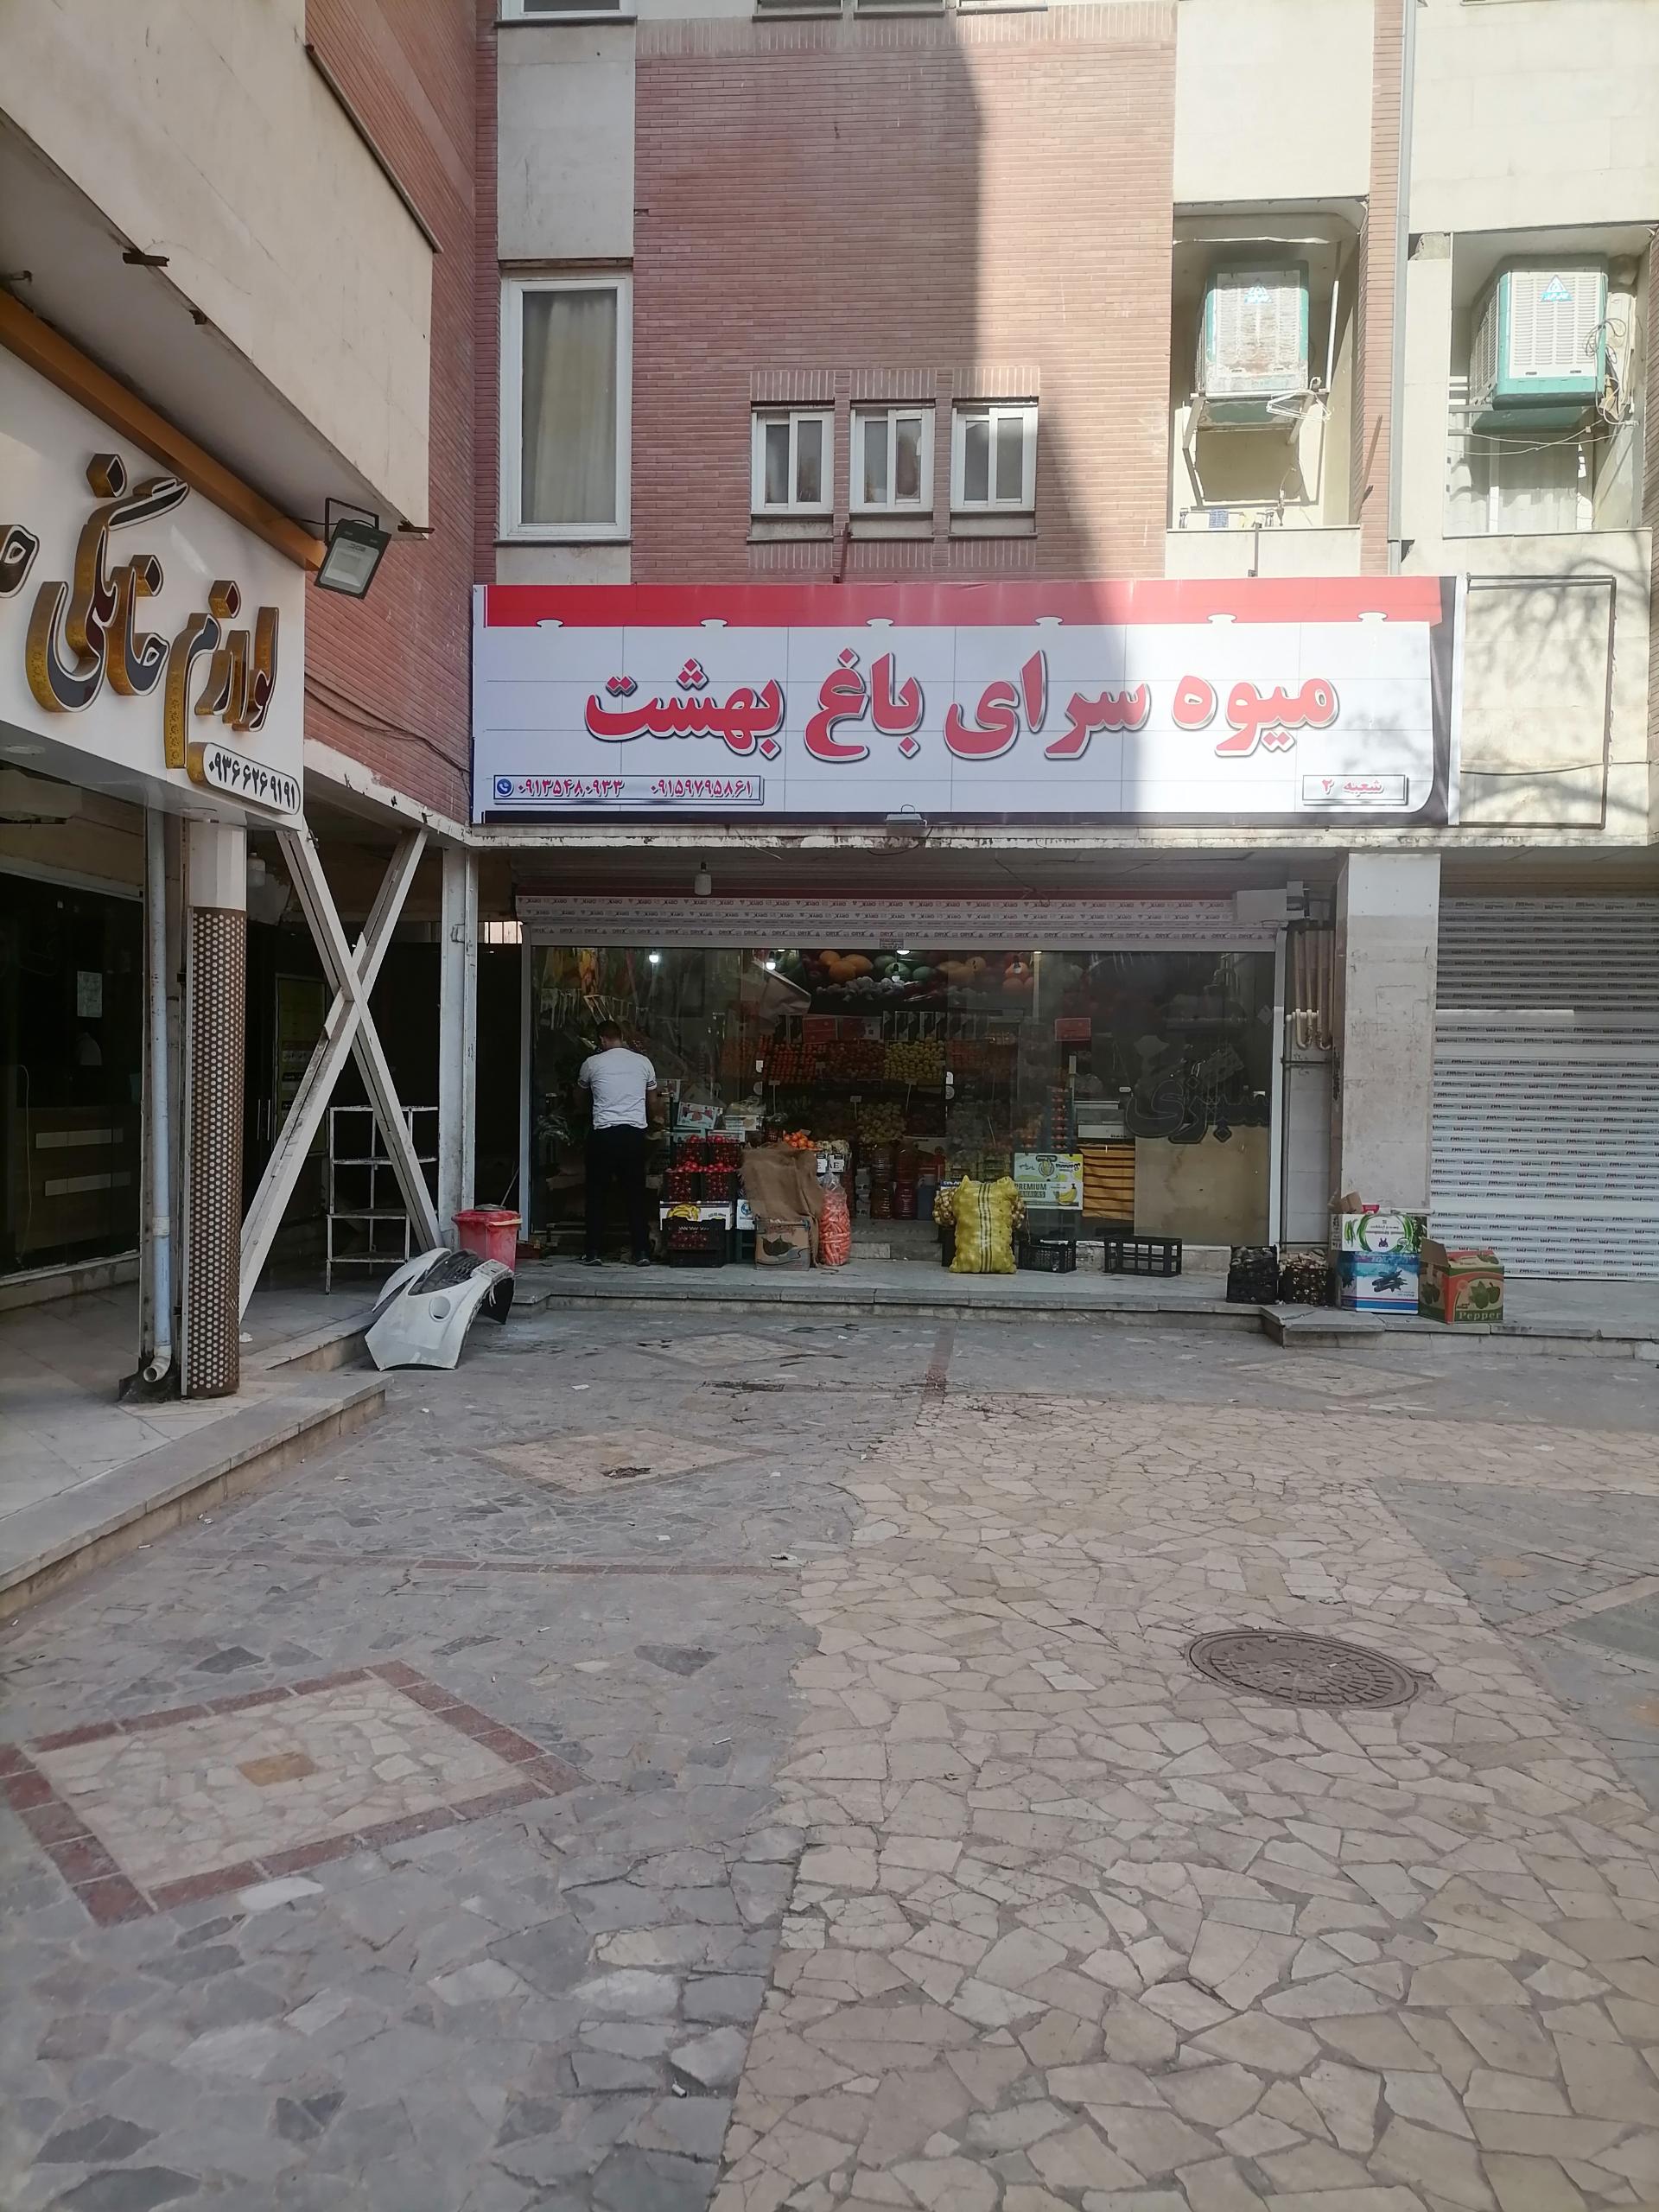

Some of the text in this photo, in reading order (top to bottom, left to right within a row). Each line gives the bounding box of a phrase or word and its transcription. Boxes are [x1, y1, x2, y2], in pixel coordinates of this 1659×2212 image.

[25, 453, 280, 769] لوازم خانگی
[585, 647, 1339, 761] میوه سرای باغ بهشت
[518, 779, 753, 798] ۰۹۱۳۵۴۸۰۹۳۳ ۰۹۱۵۹۷۹۵۸۶۱
[1322, 779, 1384, 797] شعبه ۲
[1459, 1312, 1501, 1321] Pepper
